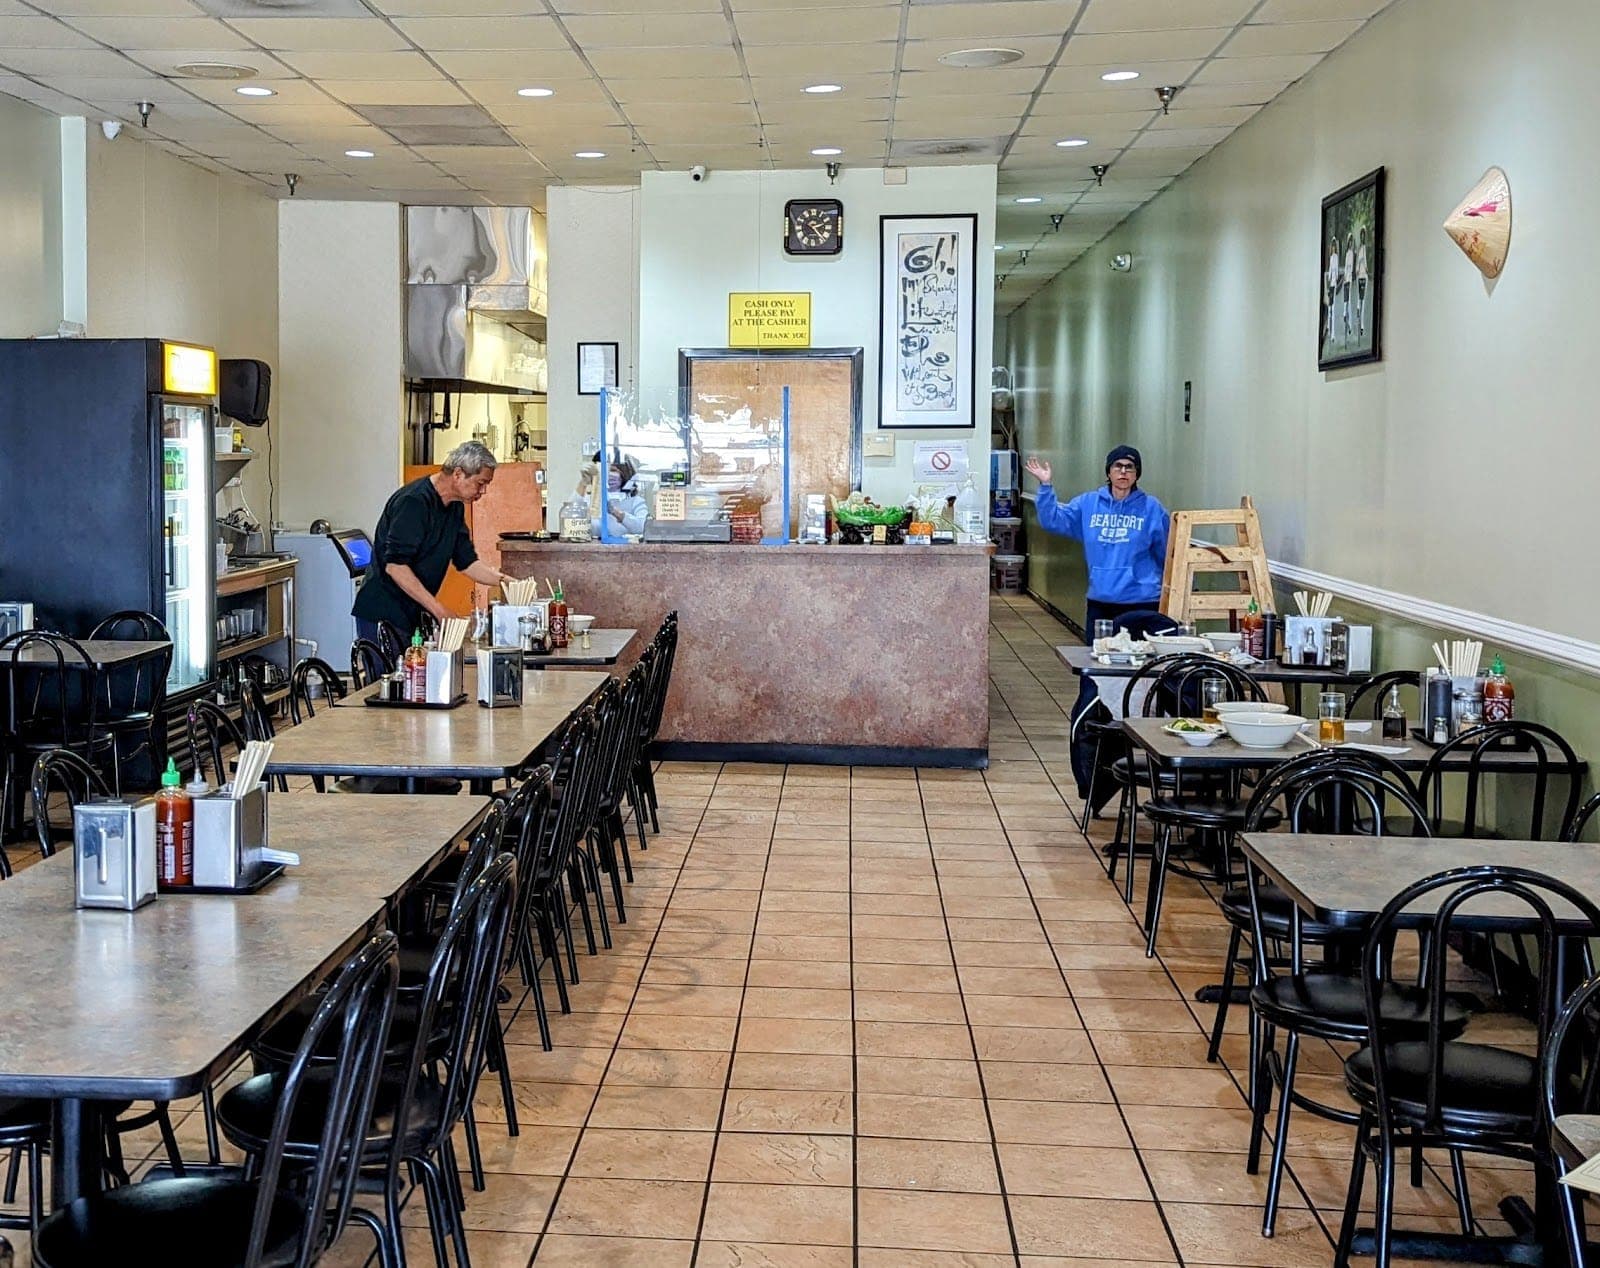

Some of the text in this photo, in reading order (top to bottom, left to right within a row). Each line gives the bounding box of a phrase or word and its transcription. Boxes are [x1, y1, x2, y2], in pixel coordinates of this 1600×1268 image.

[745, 300, 795, 308] CASH ONLY
[744, 309, 797, 317] PLEASE PAY
[733, 318, 807, 326] AT THE CASHIER
[1089, 513, 1145, 531] BEAUFORT
